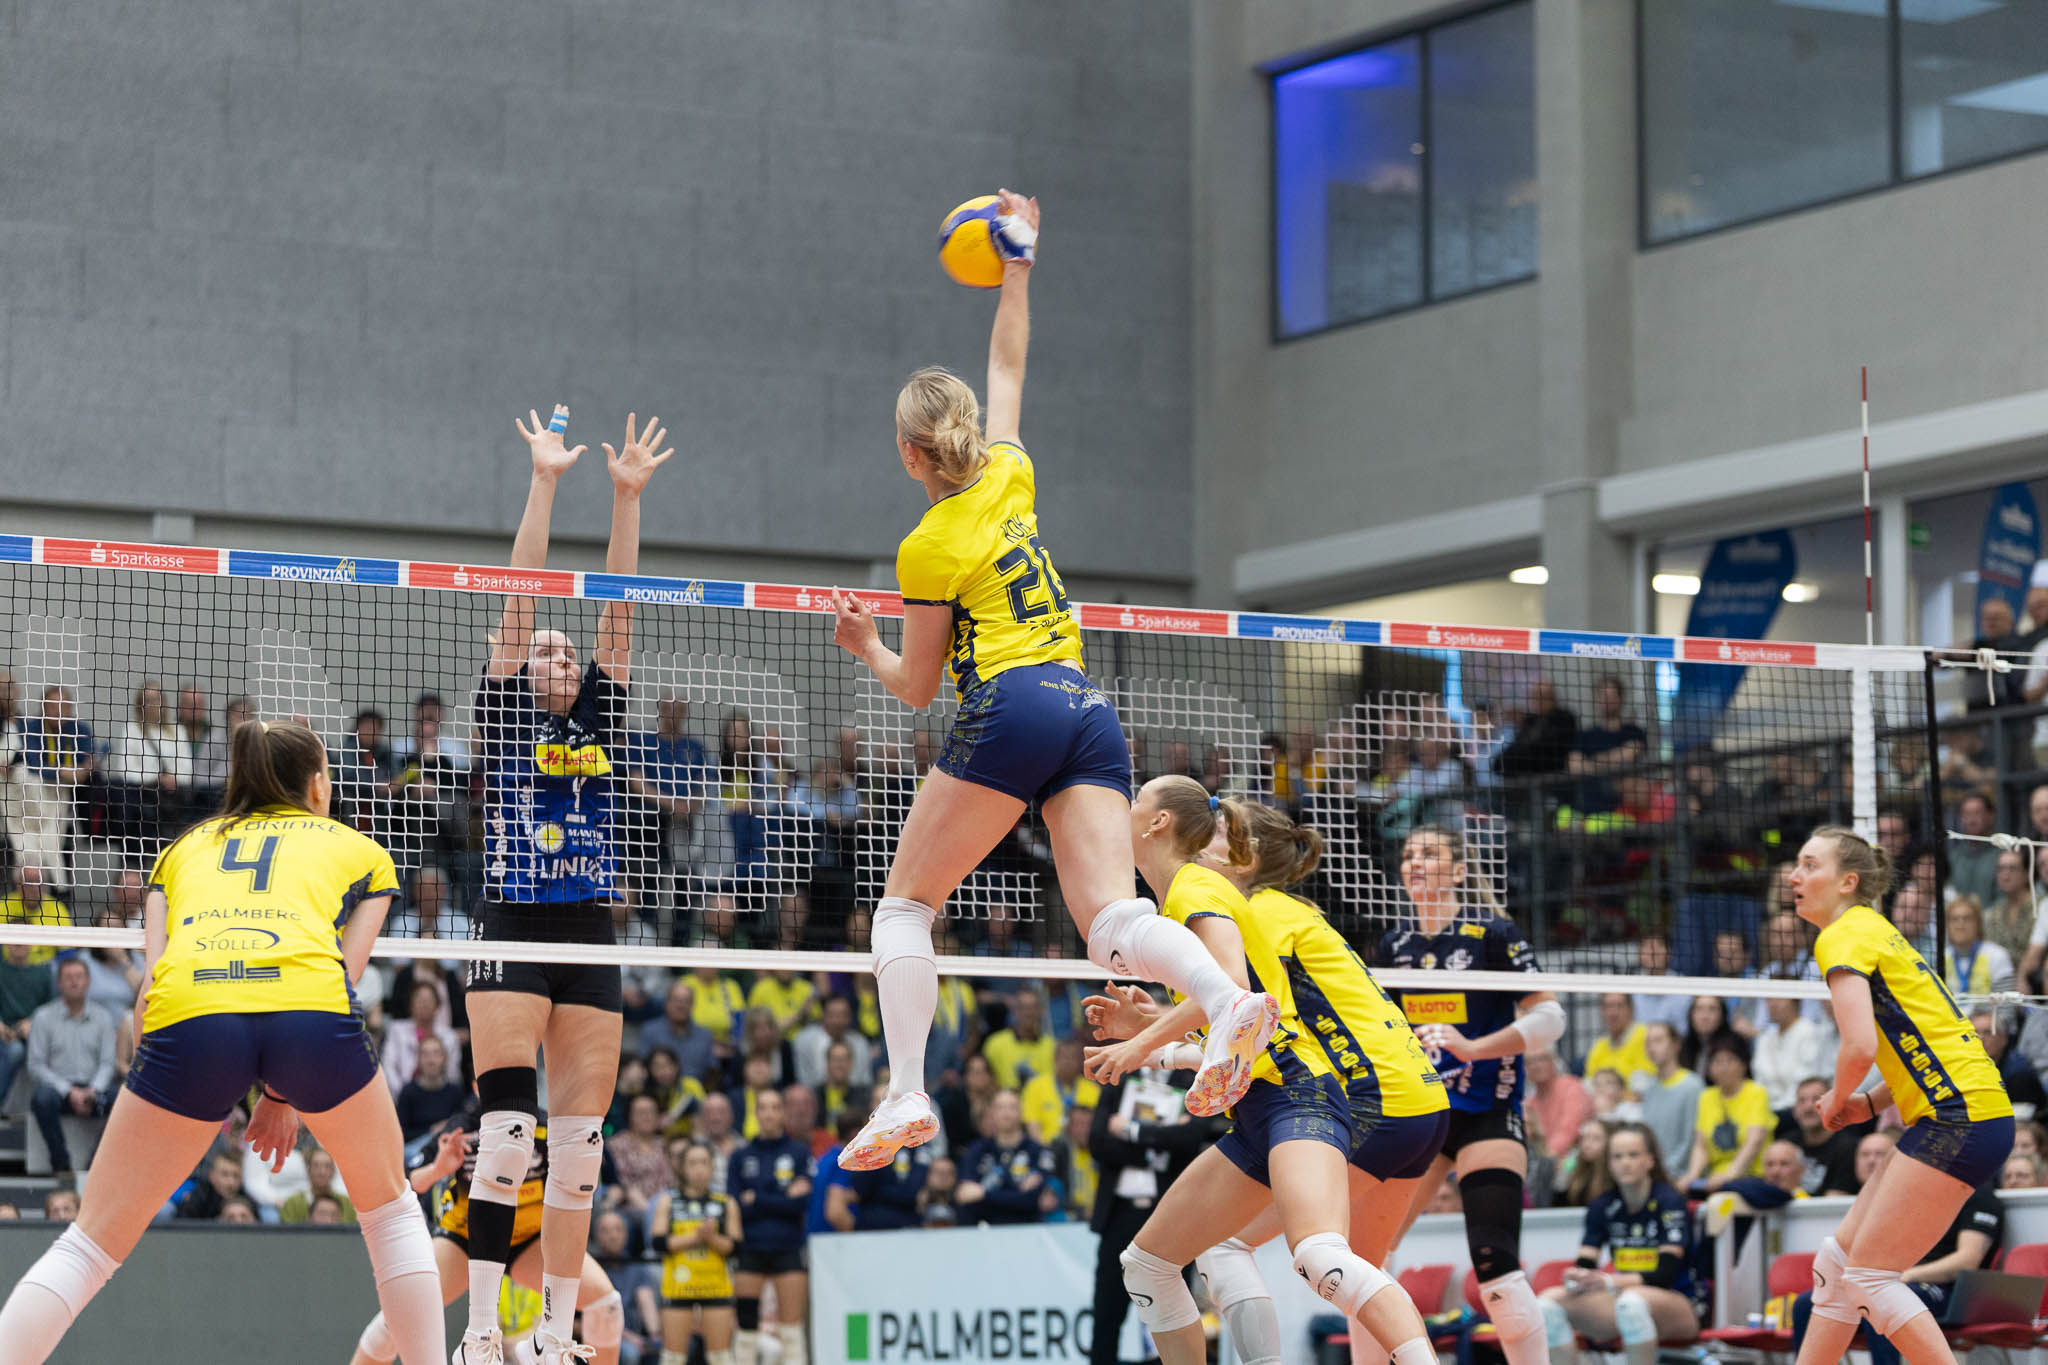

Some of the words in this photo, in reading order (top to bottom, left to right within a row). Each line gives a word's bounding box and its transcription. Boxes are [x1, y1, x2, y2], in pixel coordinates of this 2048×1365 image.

[111, 550, 185, 568] Sparkasse
[271, 565, 350, 582] PROVINZIAL
[473, 574, 542, 591] Sparkasse
[624, 588, 701, 604] PROVINZIAL
[814, 594, 881, 612] Spkse
[1137, 613, 1201, 631] Sparkasse
[1272, 626, 1341, 642] PROVINZIAL
[1443, 631, 1504, 648] Sparkasse
[1572, 642, 1638, 657] PROVINZIAL
[1734, 647, 1792, 663] Sparkasse
[217, 834, 285, 894] 4
[192, 936, 262, 952] STOLLE
[1418, 1001, 1457, 1014] LOTTO
